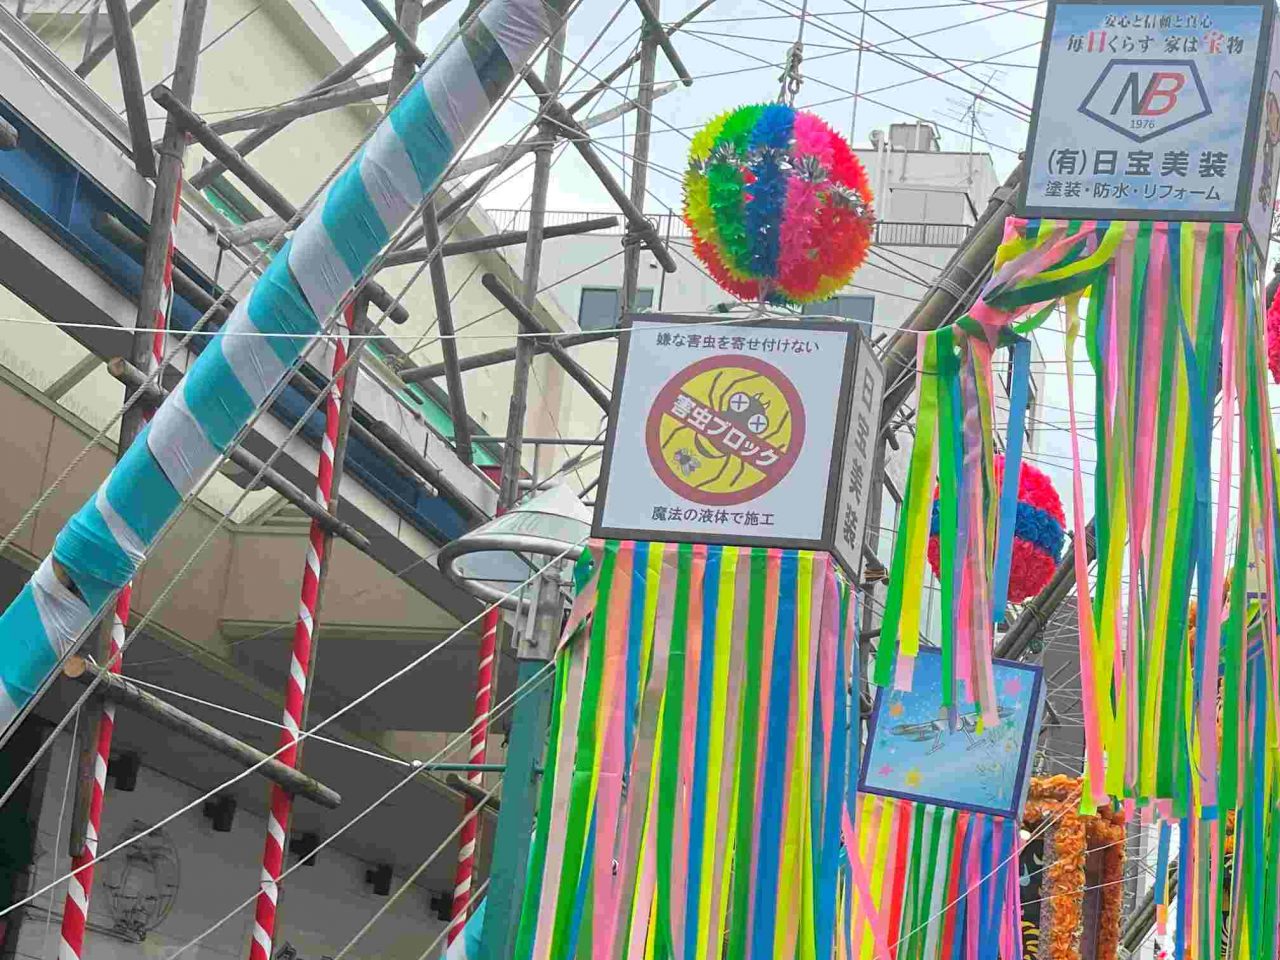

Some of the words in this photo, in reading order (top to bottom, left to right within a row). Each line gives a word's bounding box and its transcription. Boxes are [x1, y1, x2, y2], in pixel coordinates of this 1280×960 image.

[1104, 15, 1212, 28] 安心と信頼と真心
[1067, 31, 1155, 53] 毎日くらす
[1164, 30, 1243, 54] 家は宝物
[1110, 72, 1185, 116] NB
[1130, 119, 1155, 129] 1976
[656, 332, 820, 353] 嫌な害虫を寄せ付けない
[670, 394, 780, 467] 害虫ブロック
[652, 505, 775, 526] 魔法の液体で施工
